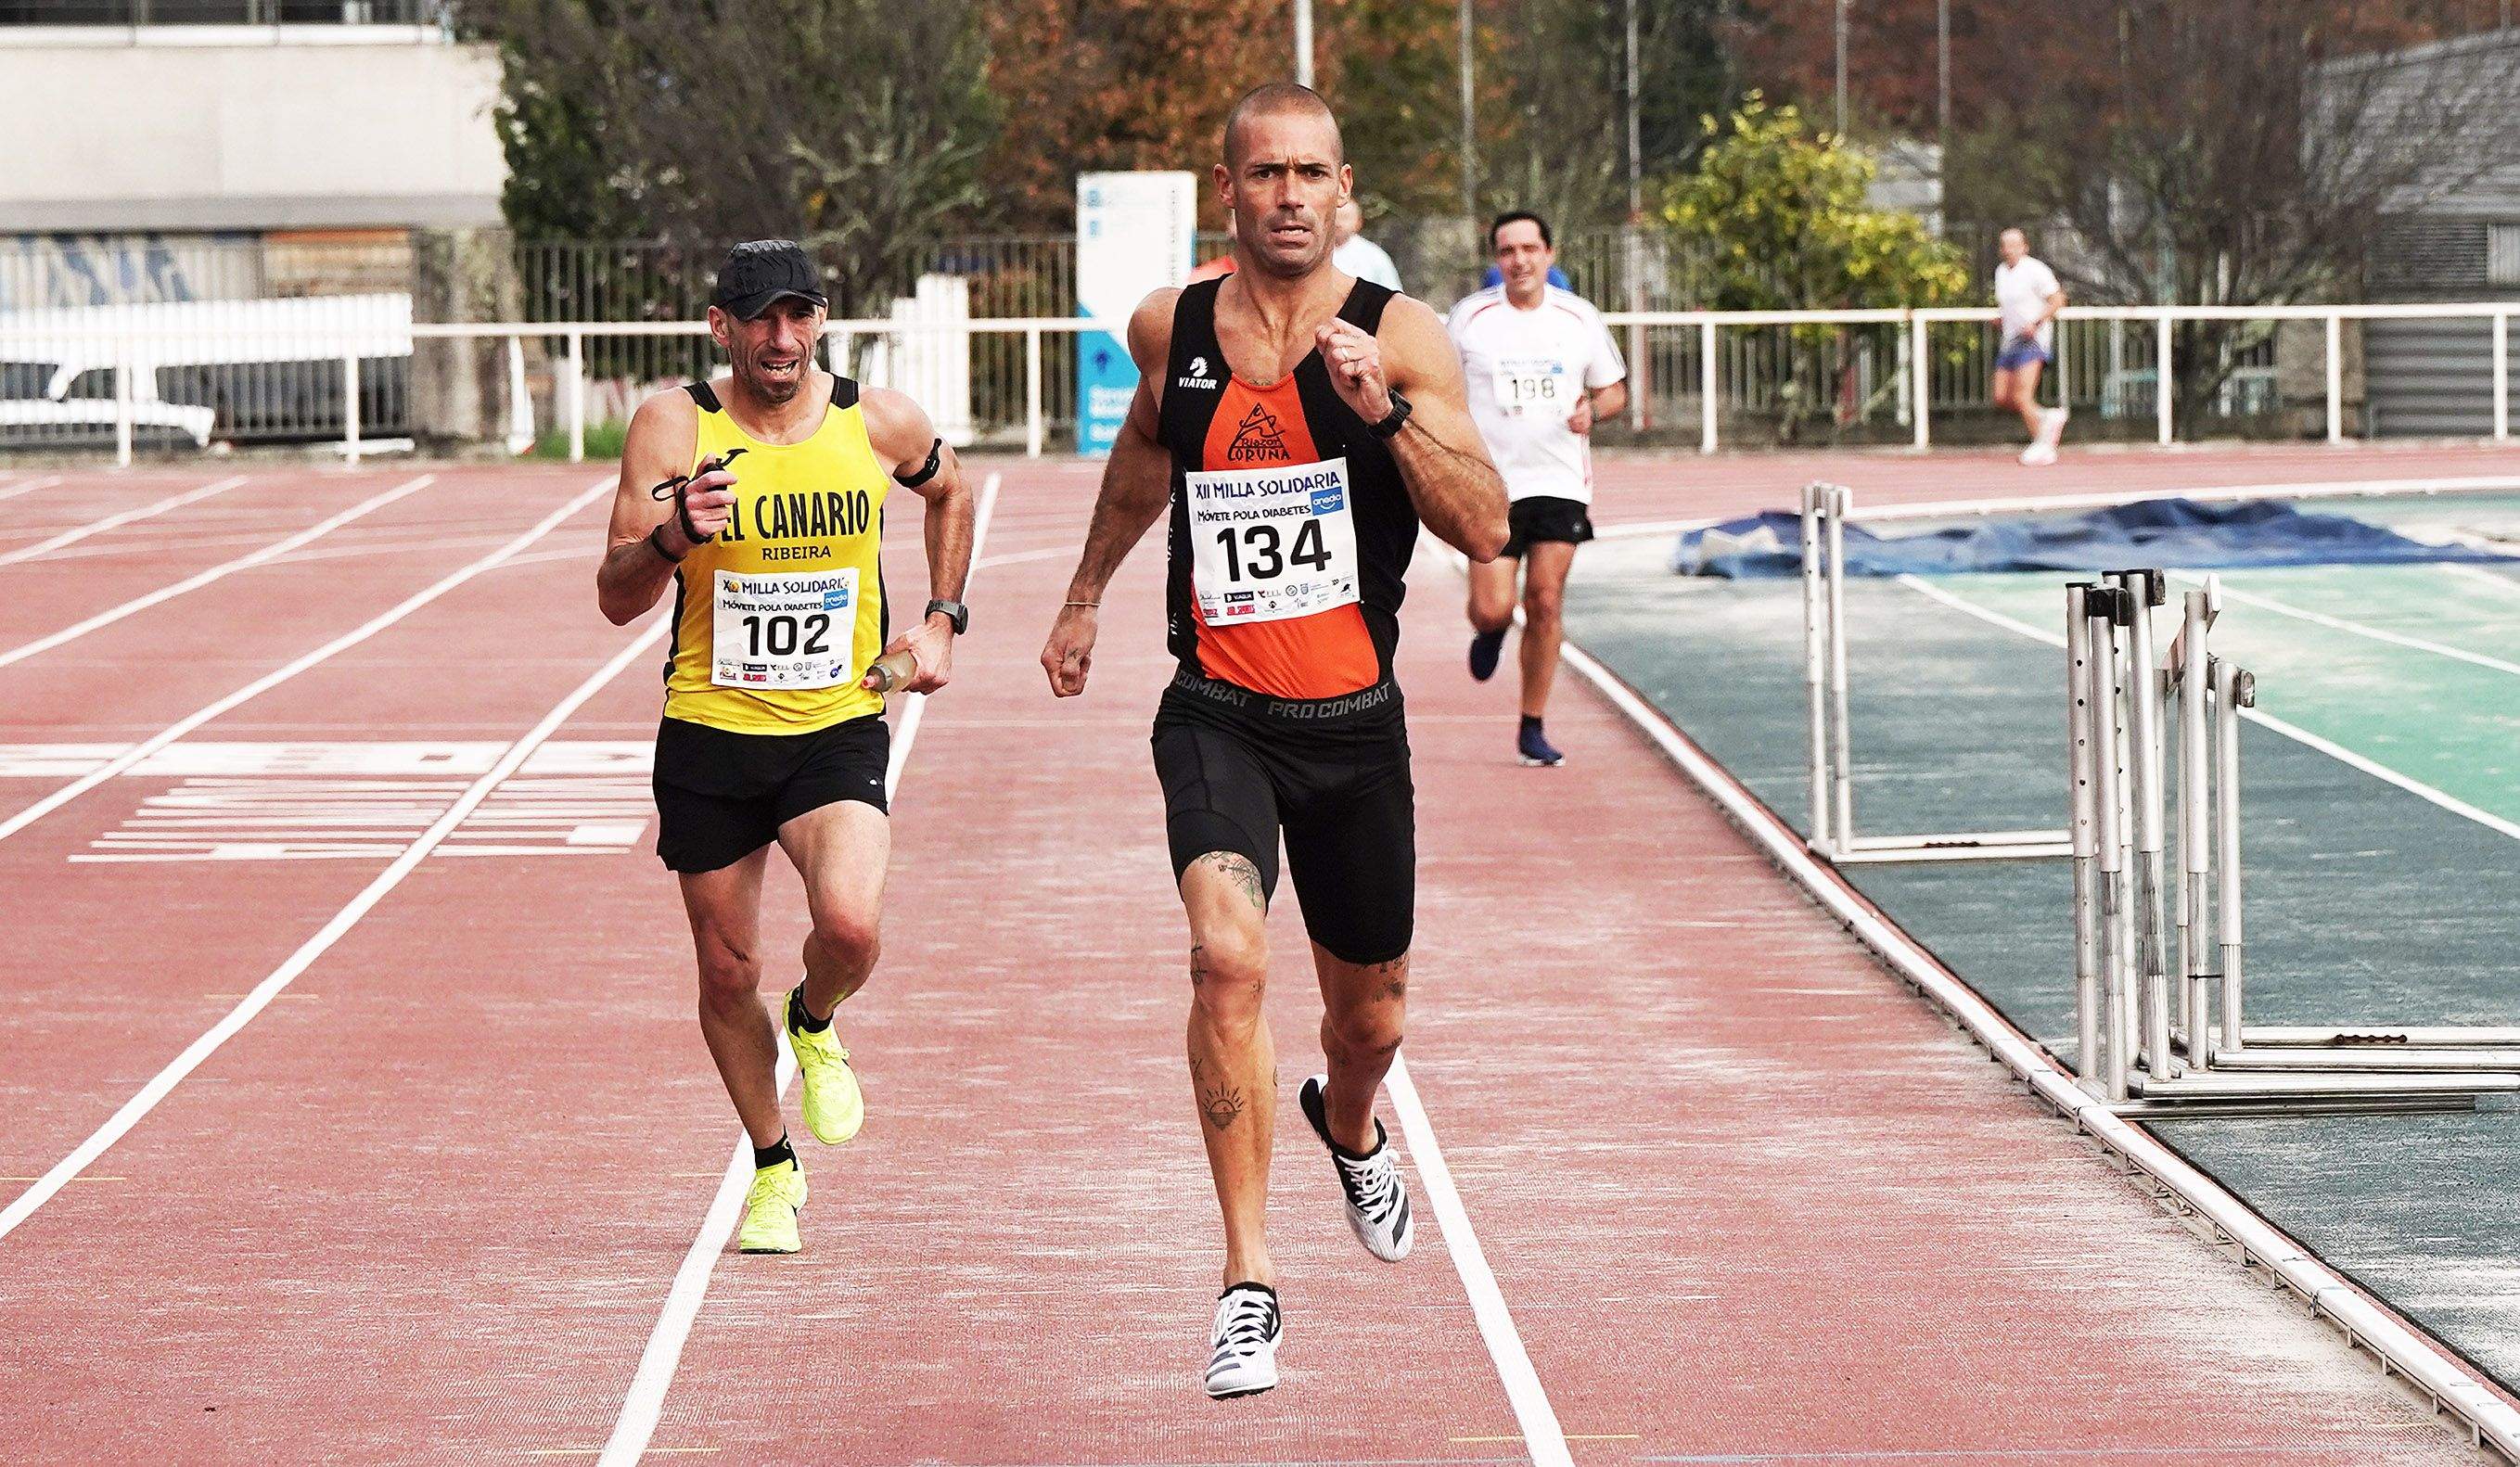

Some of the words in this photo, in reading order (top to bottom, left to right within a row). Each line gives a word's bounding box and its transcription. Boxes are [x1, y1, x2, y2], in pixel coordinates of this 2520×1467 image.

[1178, 376, 1218, 390] VIATOR
[1512, 378, 1555, 399] 198
[1195, 483, 1210, 499] XII
[1213, 481, 1256, 499] MILLA
[1258, 471, 1341, 497] SOLIDARIA
[754, 489, 870, 540] CANARIO
[1197, 509, 1231, 522] MÓVETE
[1233, 509, 1260, 520] POLA
[1262, 504, 1311, 518] DIABETES
[761, 545, 832, 561] RIBEIRA
[1216, 518, 1332, 582] 134
[742, 581, 780, 595] MILLA
[723, 599, 757, 611] MÓVETE
[758, 603, 782, 612] POLA
[784, 601, 823, 611] DIABETES
[742, 613, 830, 657] 102
[1174, 670, 1252, 707] COMBAT
[1267, 700, 1316, 719] PRO
[1317, 682, 1390, 719] COMBAT
